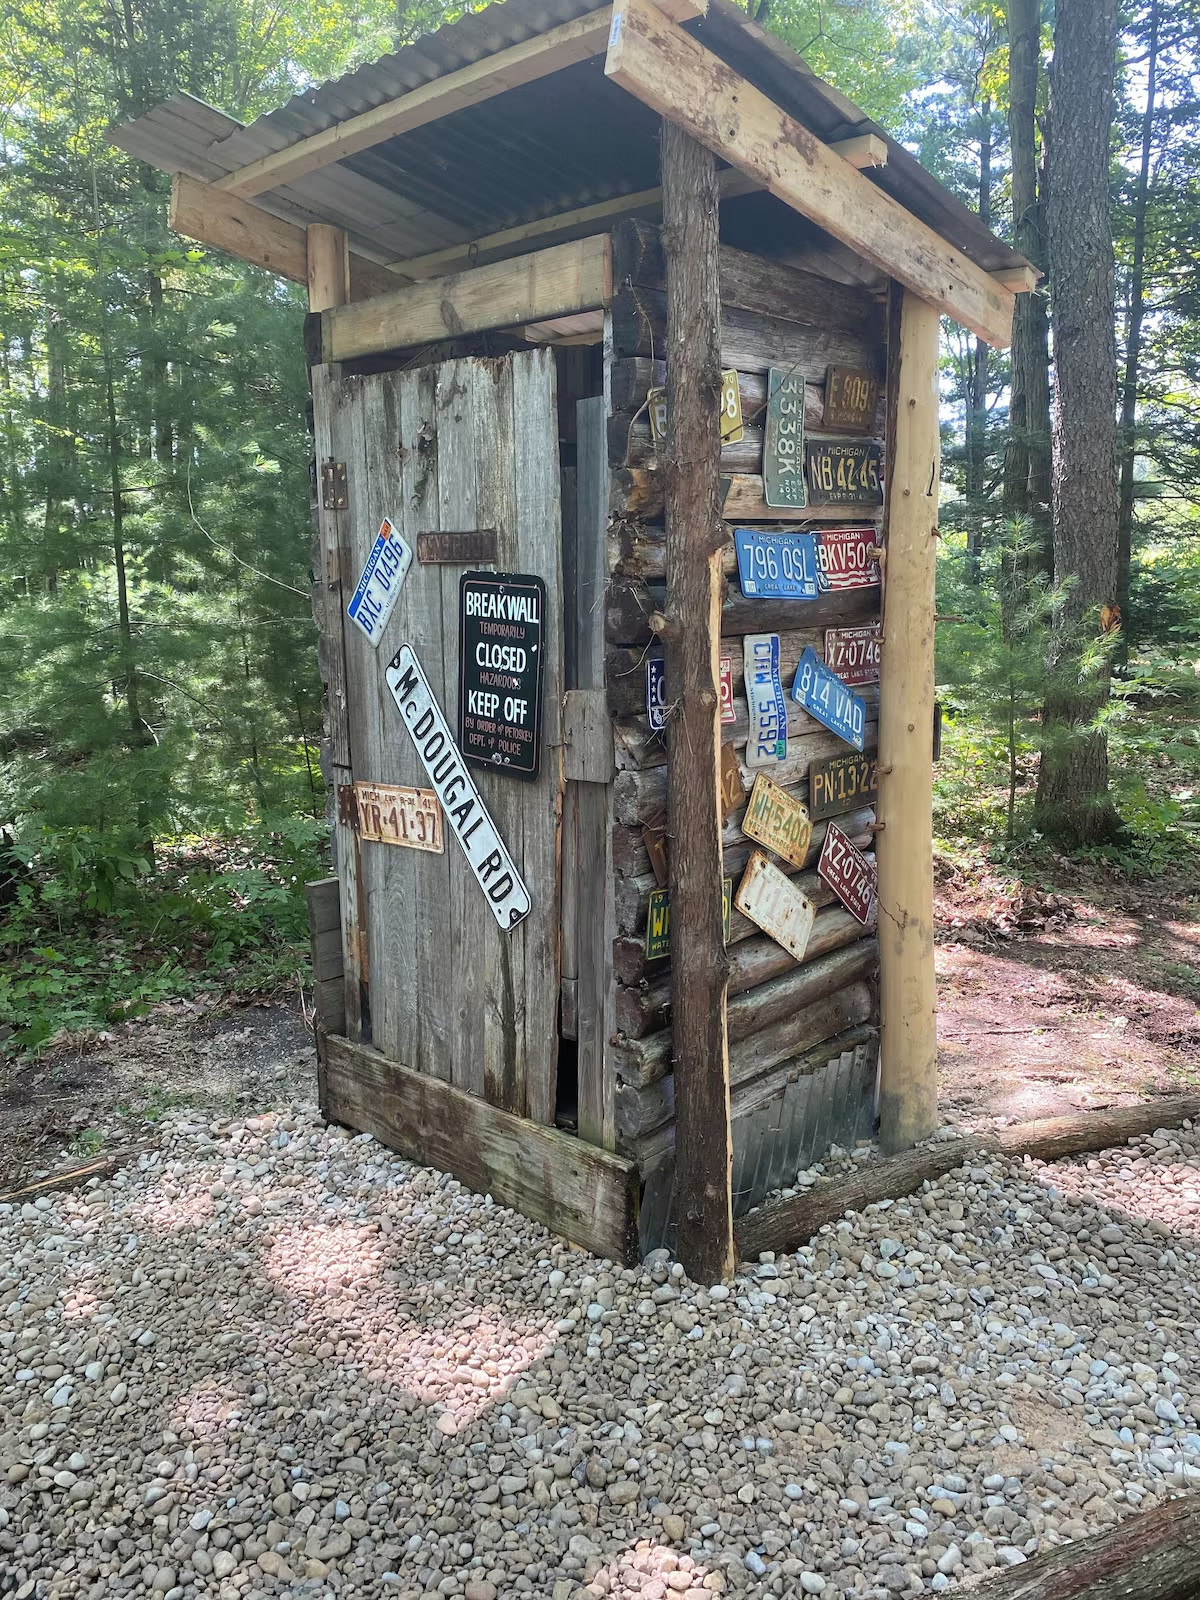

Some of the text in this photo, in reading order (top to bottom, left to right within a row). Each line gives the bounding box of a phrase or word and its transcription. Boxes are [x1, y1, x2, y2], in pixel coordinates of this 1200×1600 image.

[721, 388, 737, 418] 8
[777, 376, 797, 475] 3338K
[828, 446, 865, 457] MICHIGAN
[758, 536, 795, 546] MICHIGAN
[826, 531, 860, 541] MICHIGAN
[358, 542, 382, 595] MICHIGAN
[743, 544, 814, 581] 796 QSL
[356, 533, 404, 635] BXC 0496
[466, 591, 539, 624] BREAKWALL
[480, 621, 525, 639] TEMPORARILY
[841, 631, 870, 639] MICHIGAN
[475, 641, 527, 673] CLOSED
[480, 671, 522, 691] HAZARDOUS
[835, 671, 849, 679] REAT
[468, 689, 528, 724] KEEP OFF
[771, 667, 786, 730] MICHIGAN
[800, 663, 862, 734] 814 VAD
[465, 716, 475, 729] BY
[476, 719, 496, 734] ORDER
[504, 725, 534, 743] PETOSKEY
[757, 700, 778, 758] 5592
[813, 703, 846, 732] GREAT LAKES
[394, 664, 485, 851] McDOUGAL
[469, 732, 486, 747] DEPT.
[498, 739, 521, 756] POLICE
[829, 755, 864, 769] MICHIGAN
[362, 790, 380, 801] MICH
[422, 798, 431, 809] 41
[831, 826, 839, 836] 19
[842, 838, 869, 872] MICHIGAN
[654, 894, 663, 904] 19
[826, 866, 862, 912] GREAT LAKE STATE
